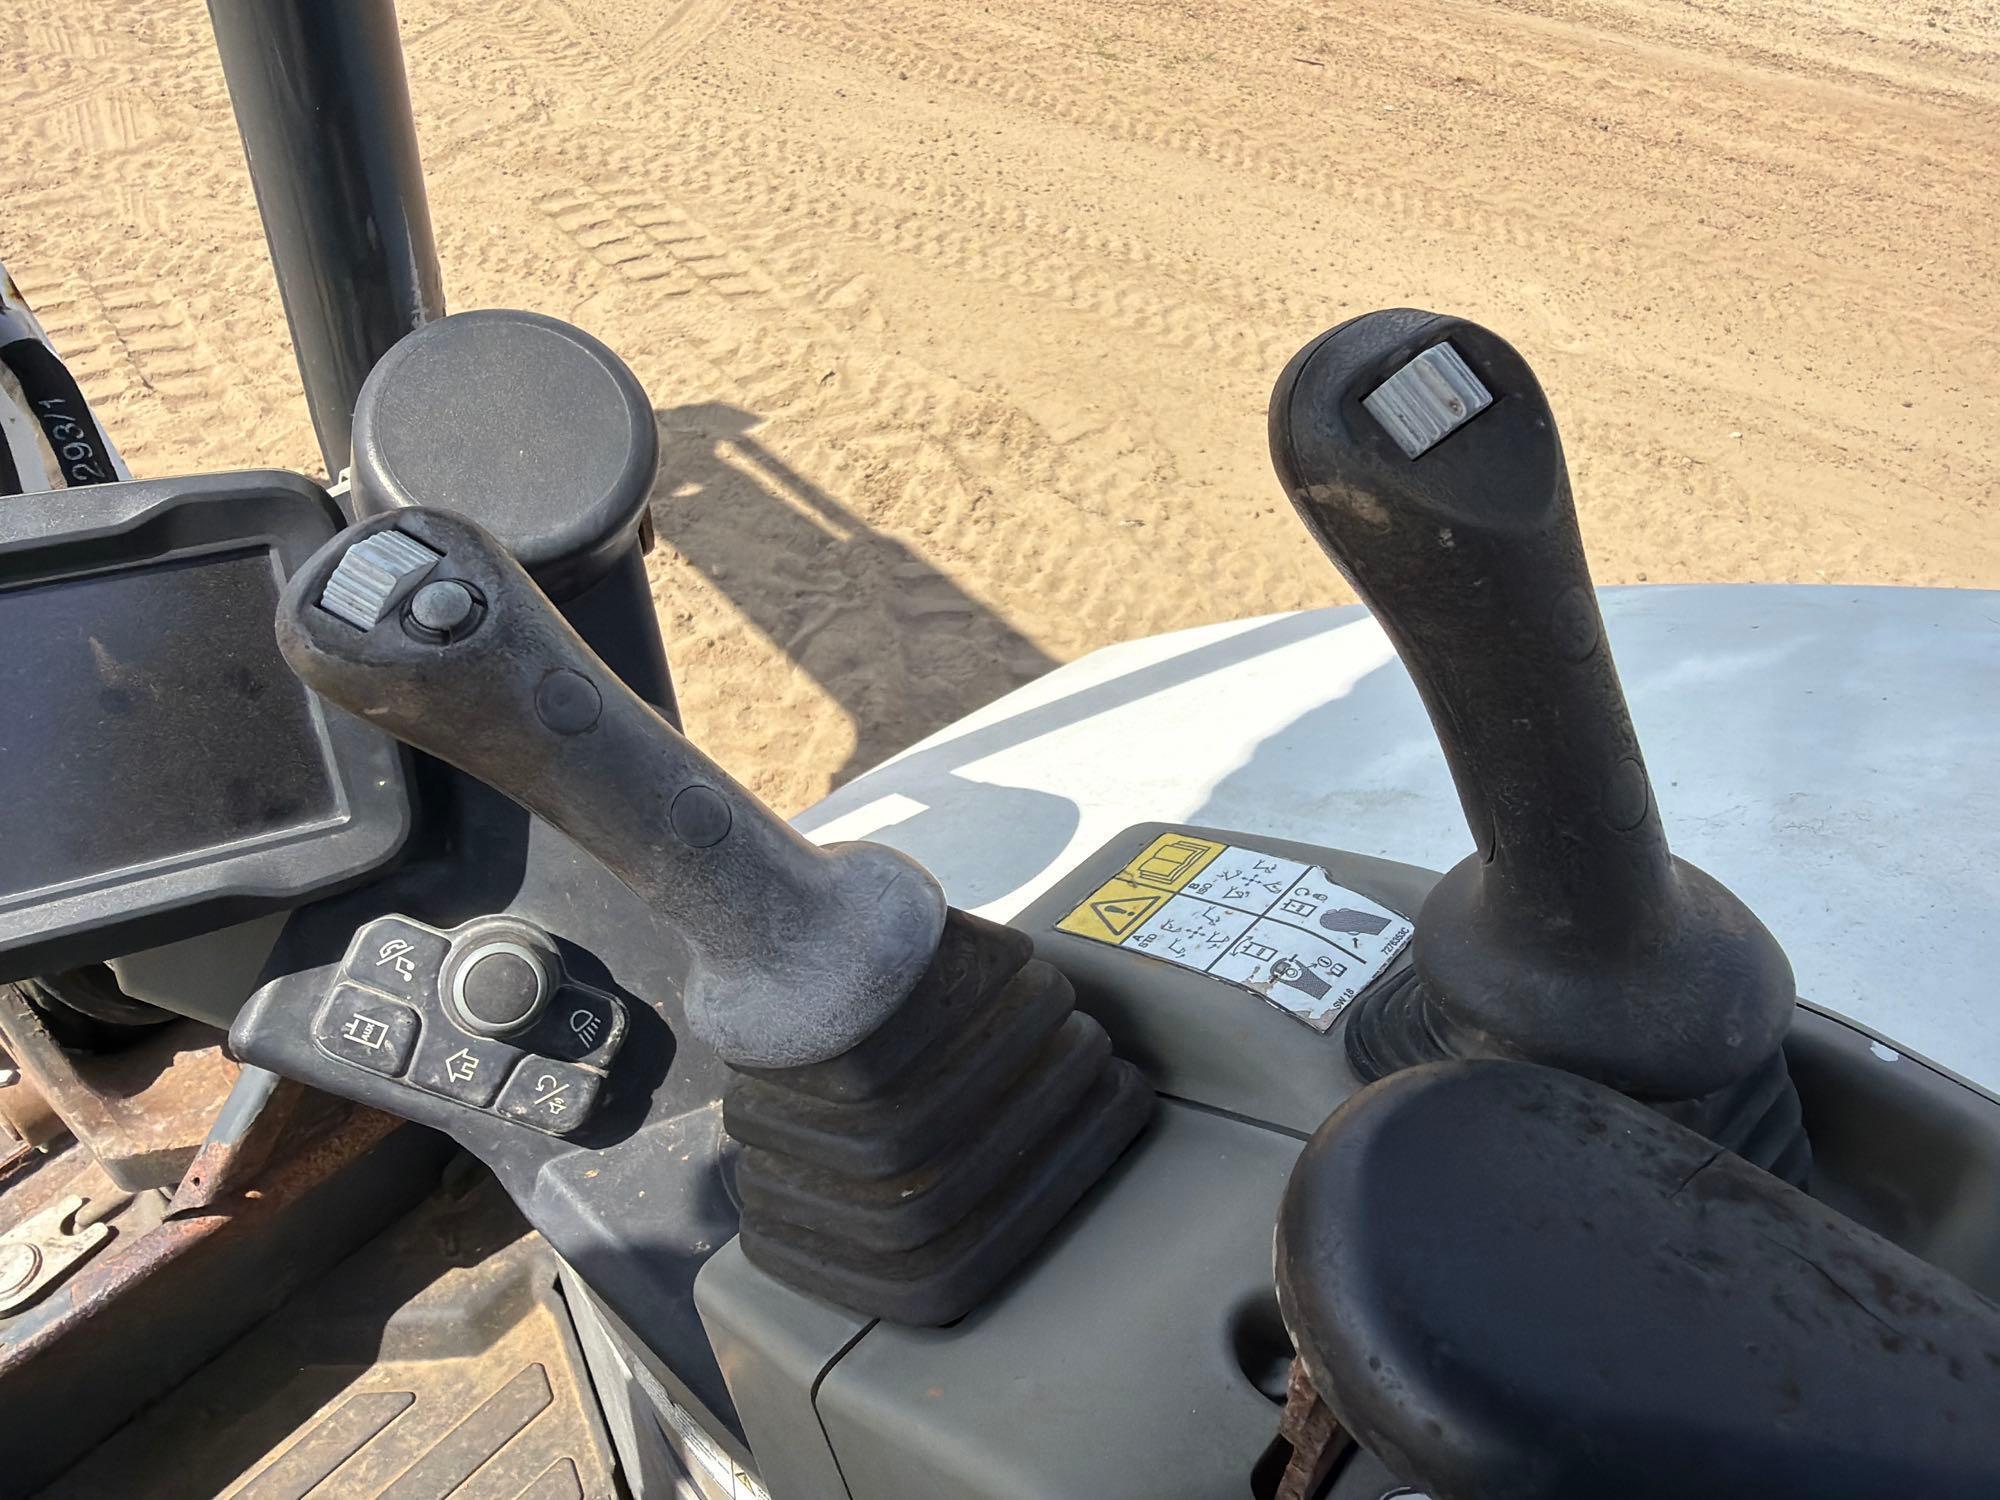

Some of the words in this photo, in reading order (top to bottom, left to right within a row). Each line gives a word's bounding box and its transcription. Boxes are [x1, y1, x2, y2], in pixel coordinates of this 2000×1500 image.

[38, 399, 105, 480] 293/1
[1188, 882, 1200, 890] B
[1195, 882, 1212, 895] ISO
[1133, 934, 1144, 942] A
[1333, 996, 1346, 1010] SW
[361, 1023, 375, 1041] AUX
